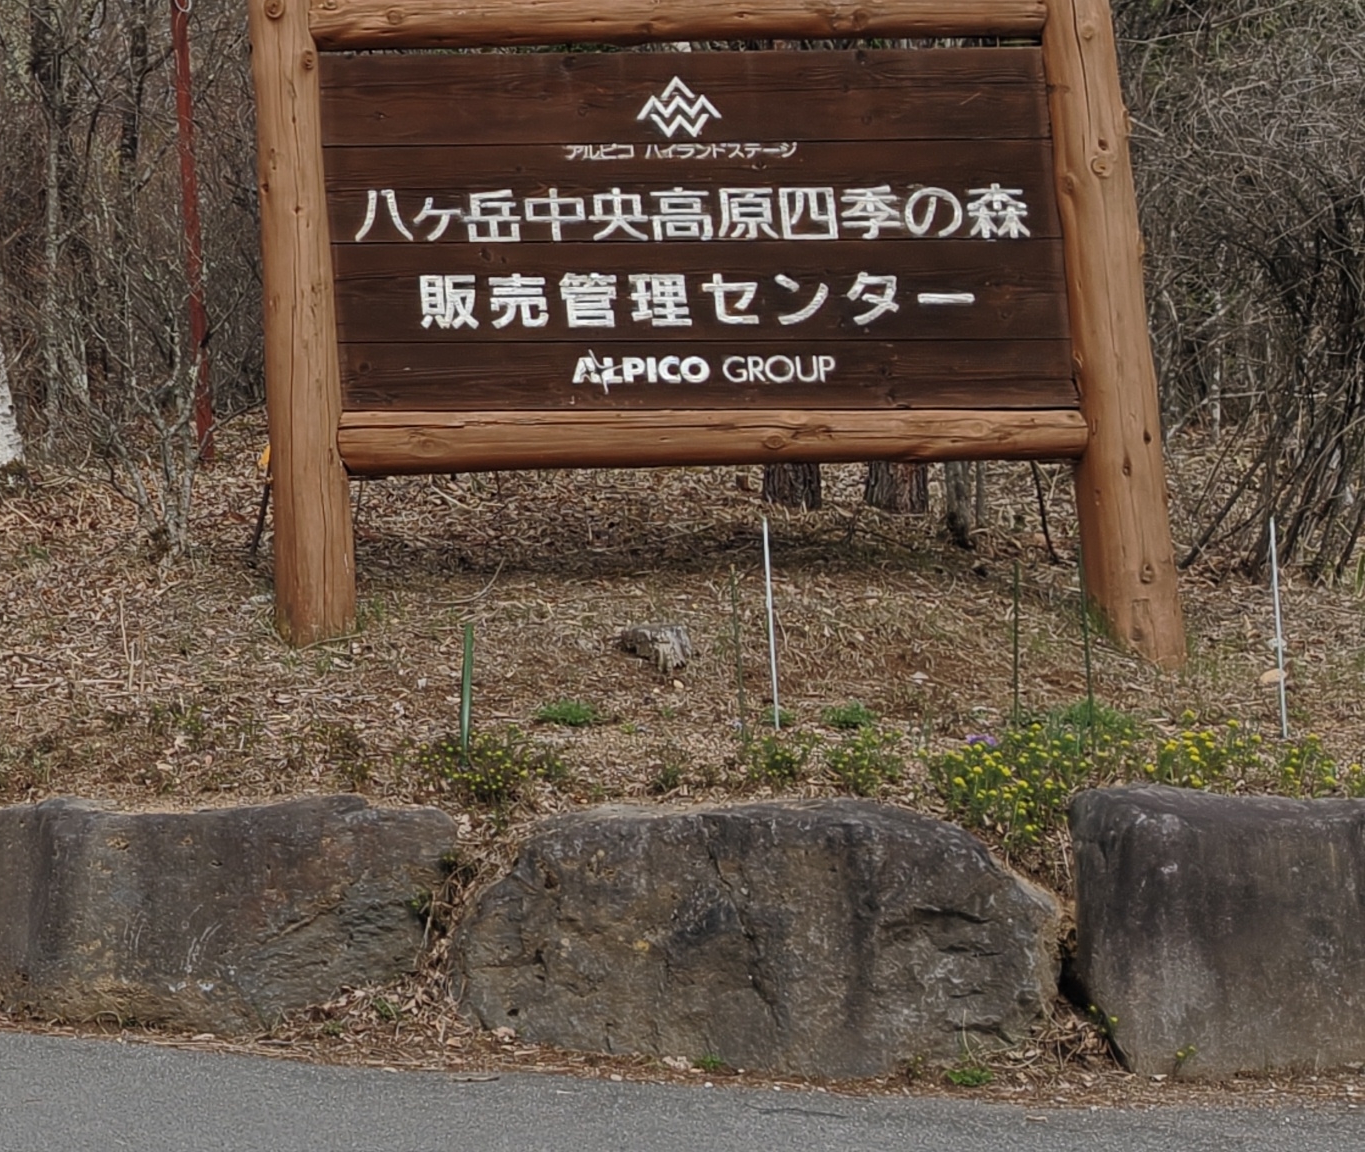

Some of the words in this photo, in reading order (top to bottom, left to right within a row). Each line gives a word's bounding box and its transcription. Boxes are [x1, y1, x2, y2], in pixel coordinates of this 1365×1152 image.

[644, 141, 798, 159] ハイランドステージ
[419, 271, 975, 330] 販売管理センター
[572, 350, 710, 393] ALPICO
[722, 355, 836, 383] GROUP
